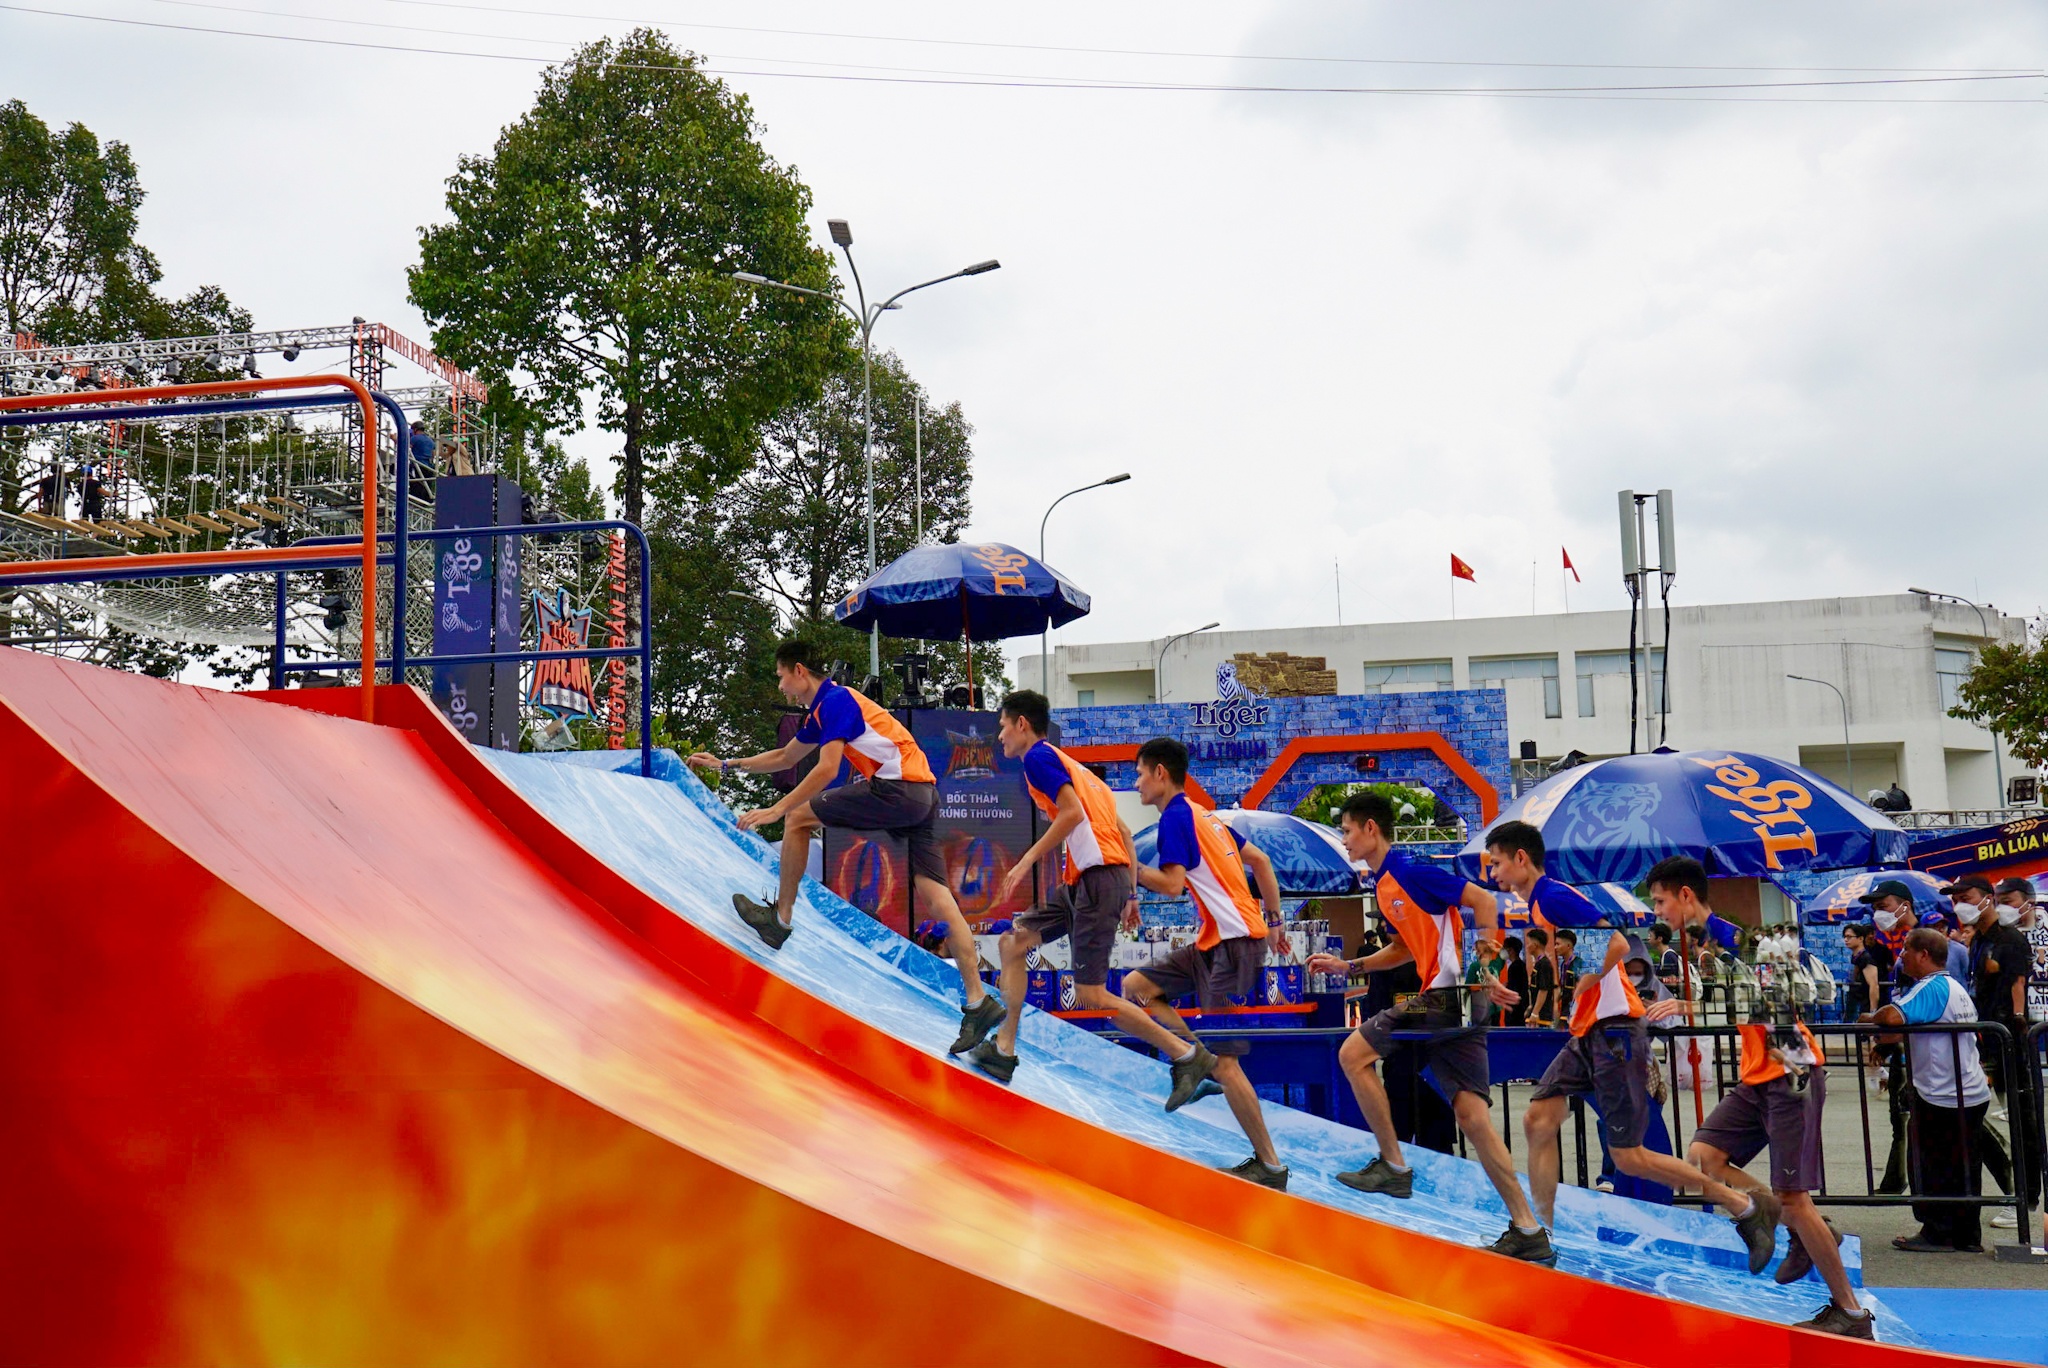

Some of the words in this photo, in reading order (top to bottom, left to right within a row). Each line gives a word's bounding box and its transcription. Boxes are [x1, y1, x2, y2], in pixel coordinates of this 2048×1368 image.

[447, 525, 482, 599] Tge
[501, 534, 518, 599] Tger
[608, 533, 627, 594] LĨNH
[971, 543, 1029, 596] Tige
[549, 619, 580, 647] Tiger
[529, 632, 598, 716] ARENA
[442, 682, 479, 731] ger
[608, 659, 627, 751] RƯỜNG
[1189, 698, 1269, 738] Tiger
[939, 805, 968, 819] RÚNG
[946, 789, 968, 804] BỐC
[1687, 754, 1818, 871] Tiger
[1977, 842, 2006, 861] BIA
[2007, 832, 2040, 854] LÚA
[2022, 929, 2048, 947] Tige
